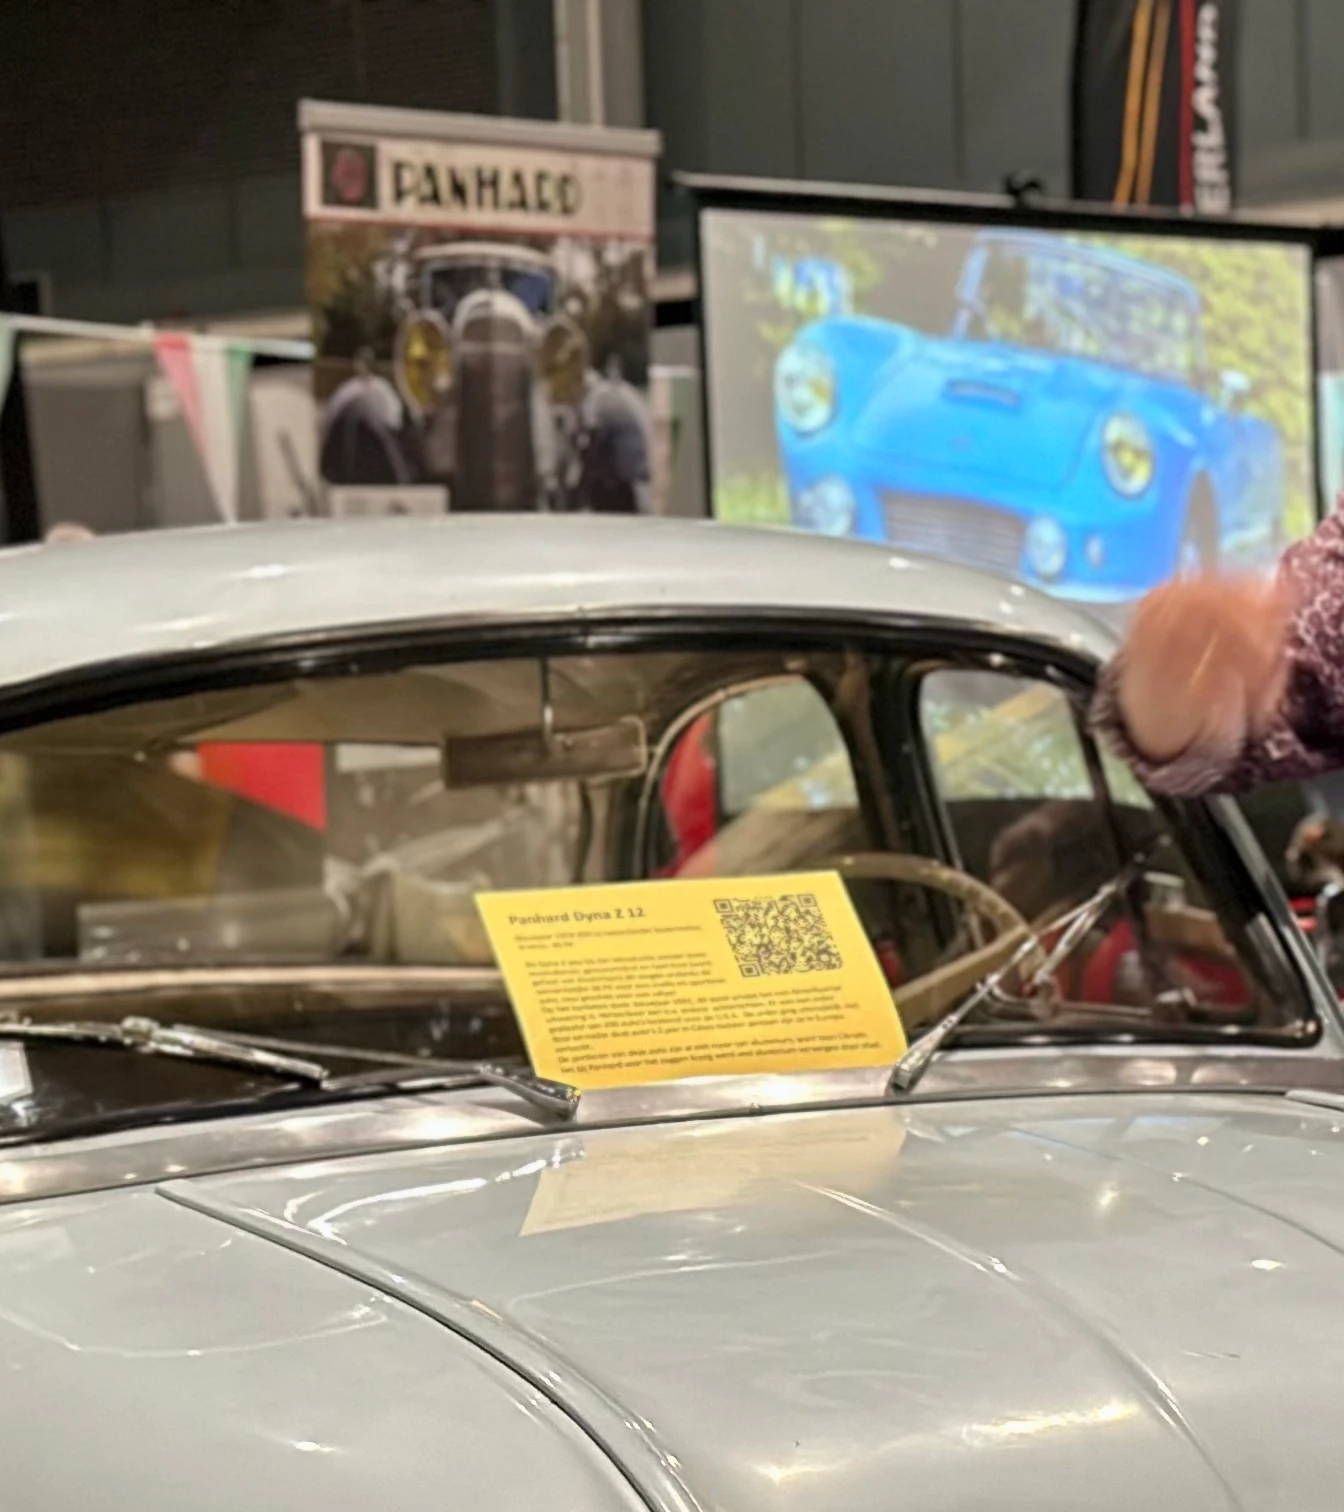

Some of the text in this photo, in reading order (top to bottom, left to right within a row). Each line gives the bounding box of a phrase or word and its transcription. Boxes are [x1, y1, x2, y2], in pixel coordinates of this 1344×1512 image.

[391, 160, 582, 217] PANHARD
[508, 907, 645, 925] Panhard Dyna Z 12
